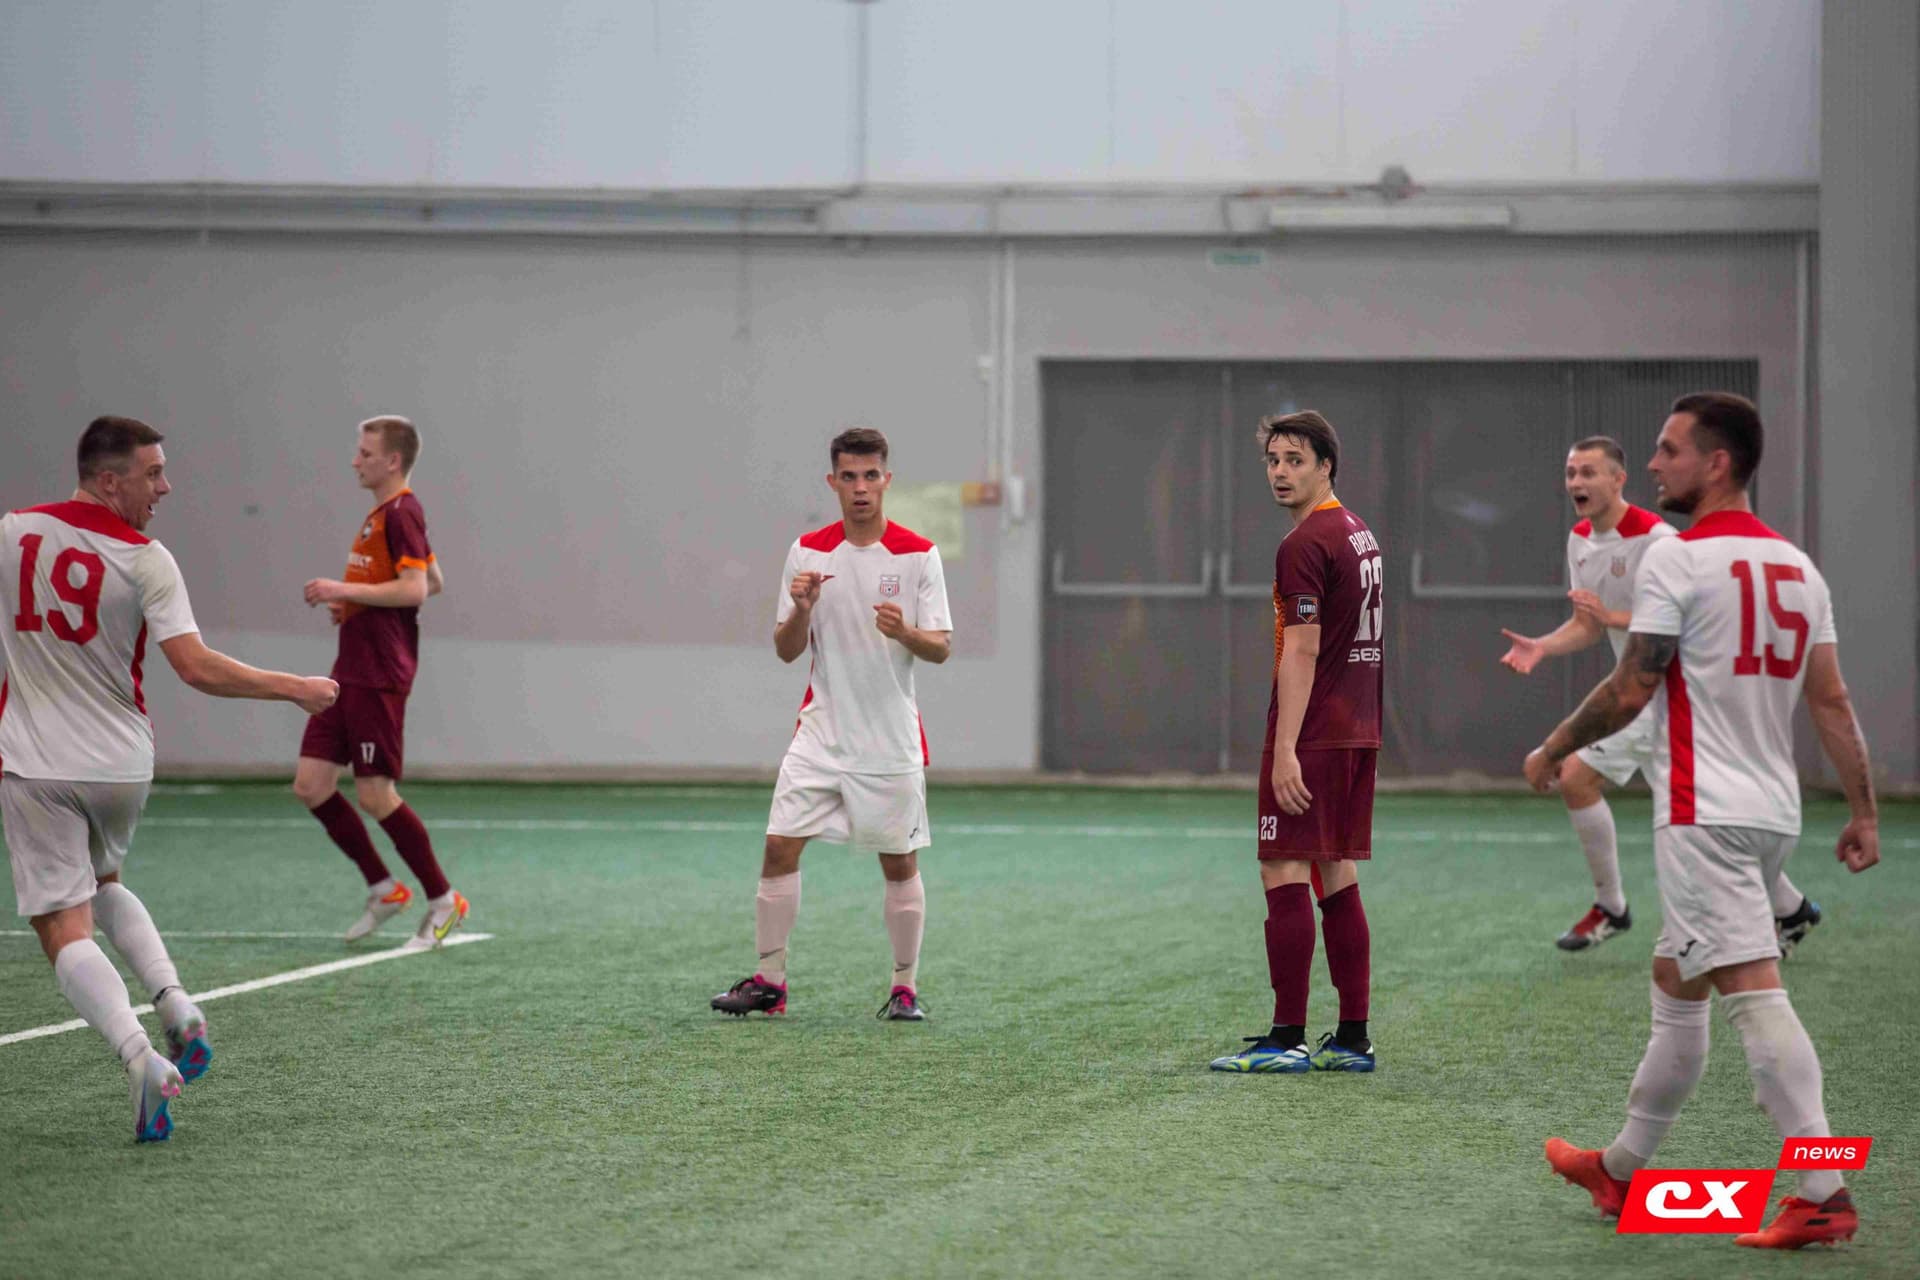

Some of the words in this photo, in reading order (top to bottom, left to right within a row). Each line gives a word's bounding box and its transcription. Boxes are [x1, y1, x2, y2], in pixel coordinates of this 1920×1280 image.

[14, 532, 106, 647] 19
[1354, 555, 1383, 642] 23
[1730, 559, 1810, 680] 15
[360, 741, 376, 764] 17
[1260, 815, 1278, 841] 23
